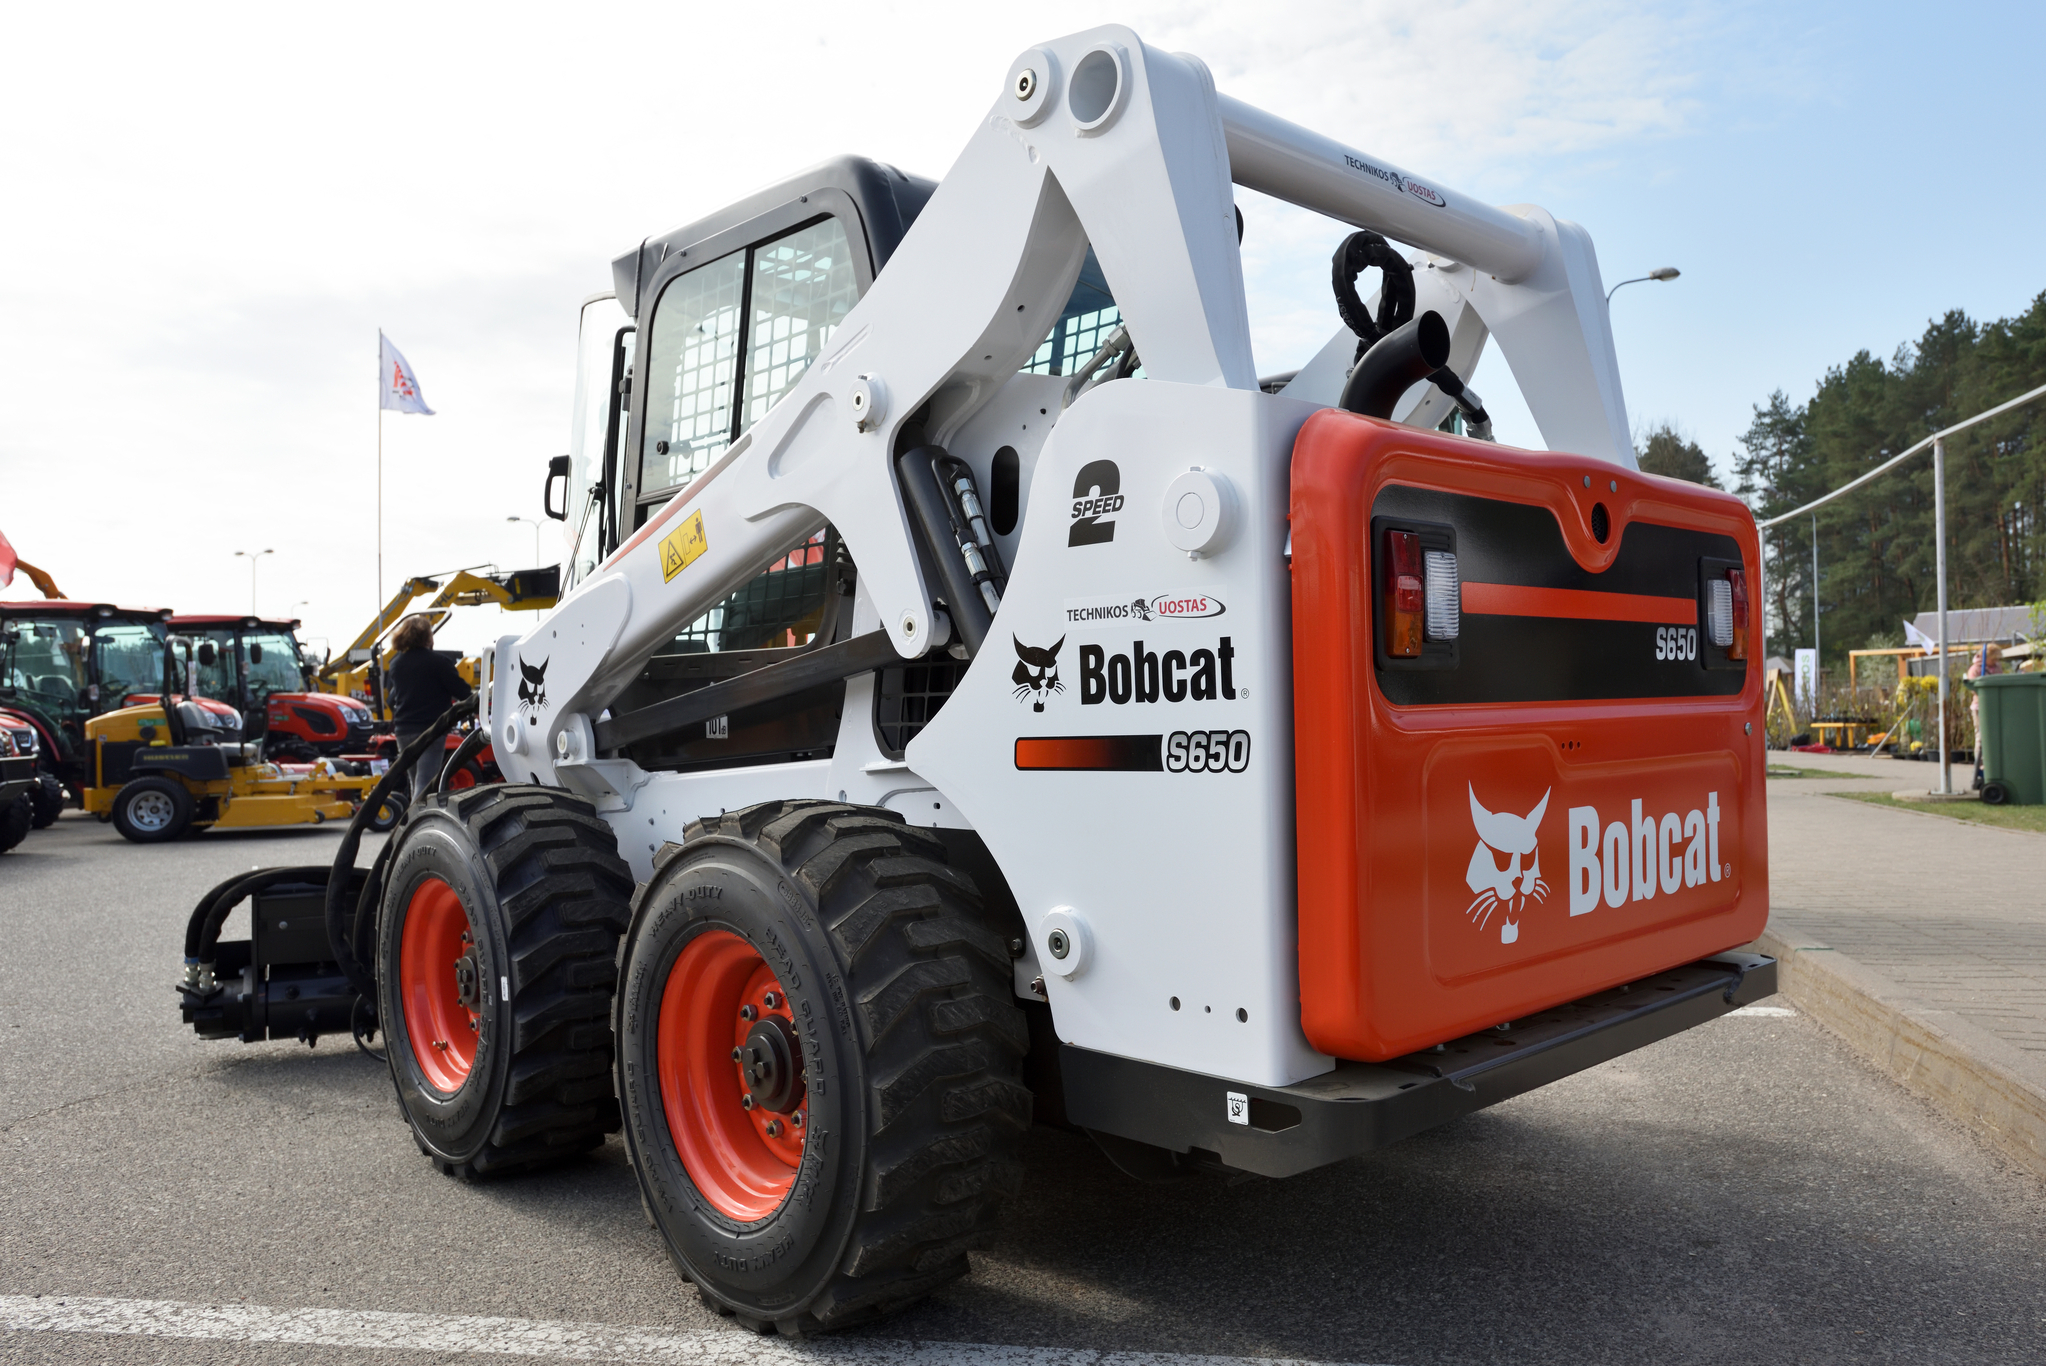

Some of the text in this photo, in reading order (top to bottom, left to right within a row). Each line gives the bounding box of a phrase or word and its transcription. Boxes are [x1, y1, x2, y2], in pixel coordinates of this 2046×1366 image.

[1344, 154, 1437, 201] TECHNIKOS UOSTAS
[1067, 459, 1121, 548] 2
[1071, 494, 1125, 519] SPEED
[1067, 598, 1207, 622] TECHNIKOS UOSTAS
[1656, 627, 1697, 661] S650
[1079, 636, 1237, 705] Bobcat
[1166, 730, 1251, 773] S650
[1568, 791, 1722, 918] Bobcat
[649, 885, 723, 938] HEAVY DUTY
[764, 925, 802, 990] BEAD
[800, 999, 826, 1096] GUARD
